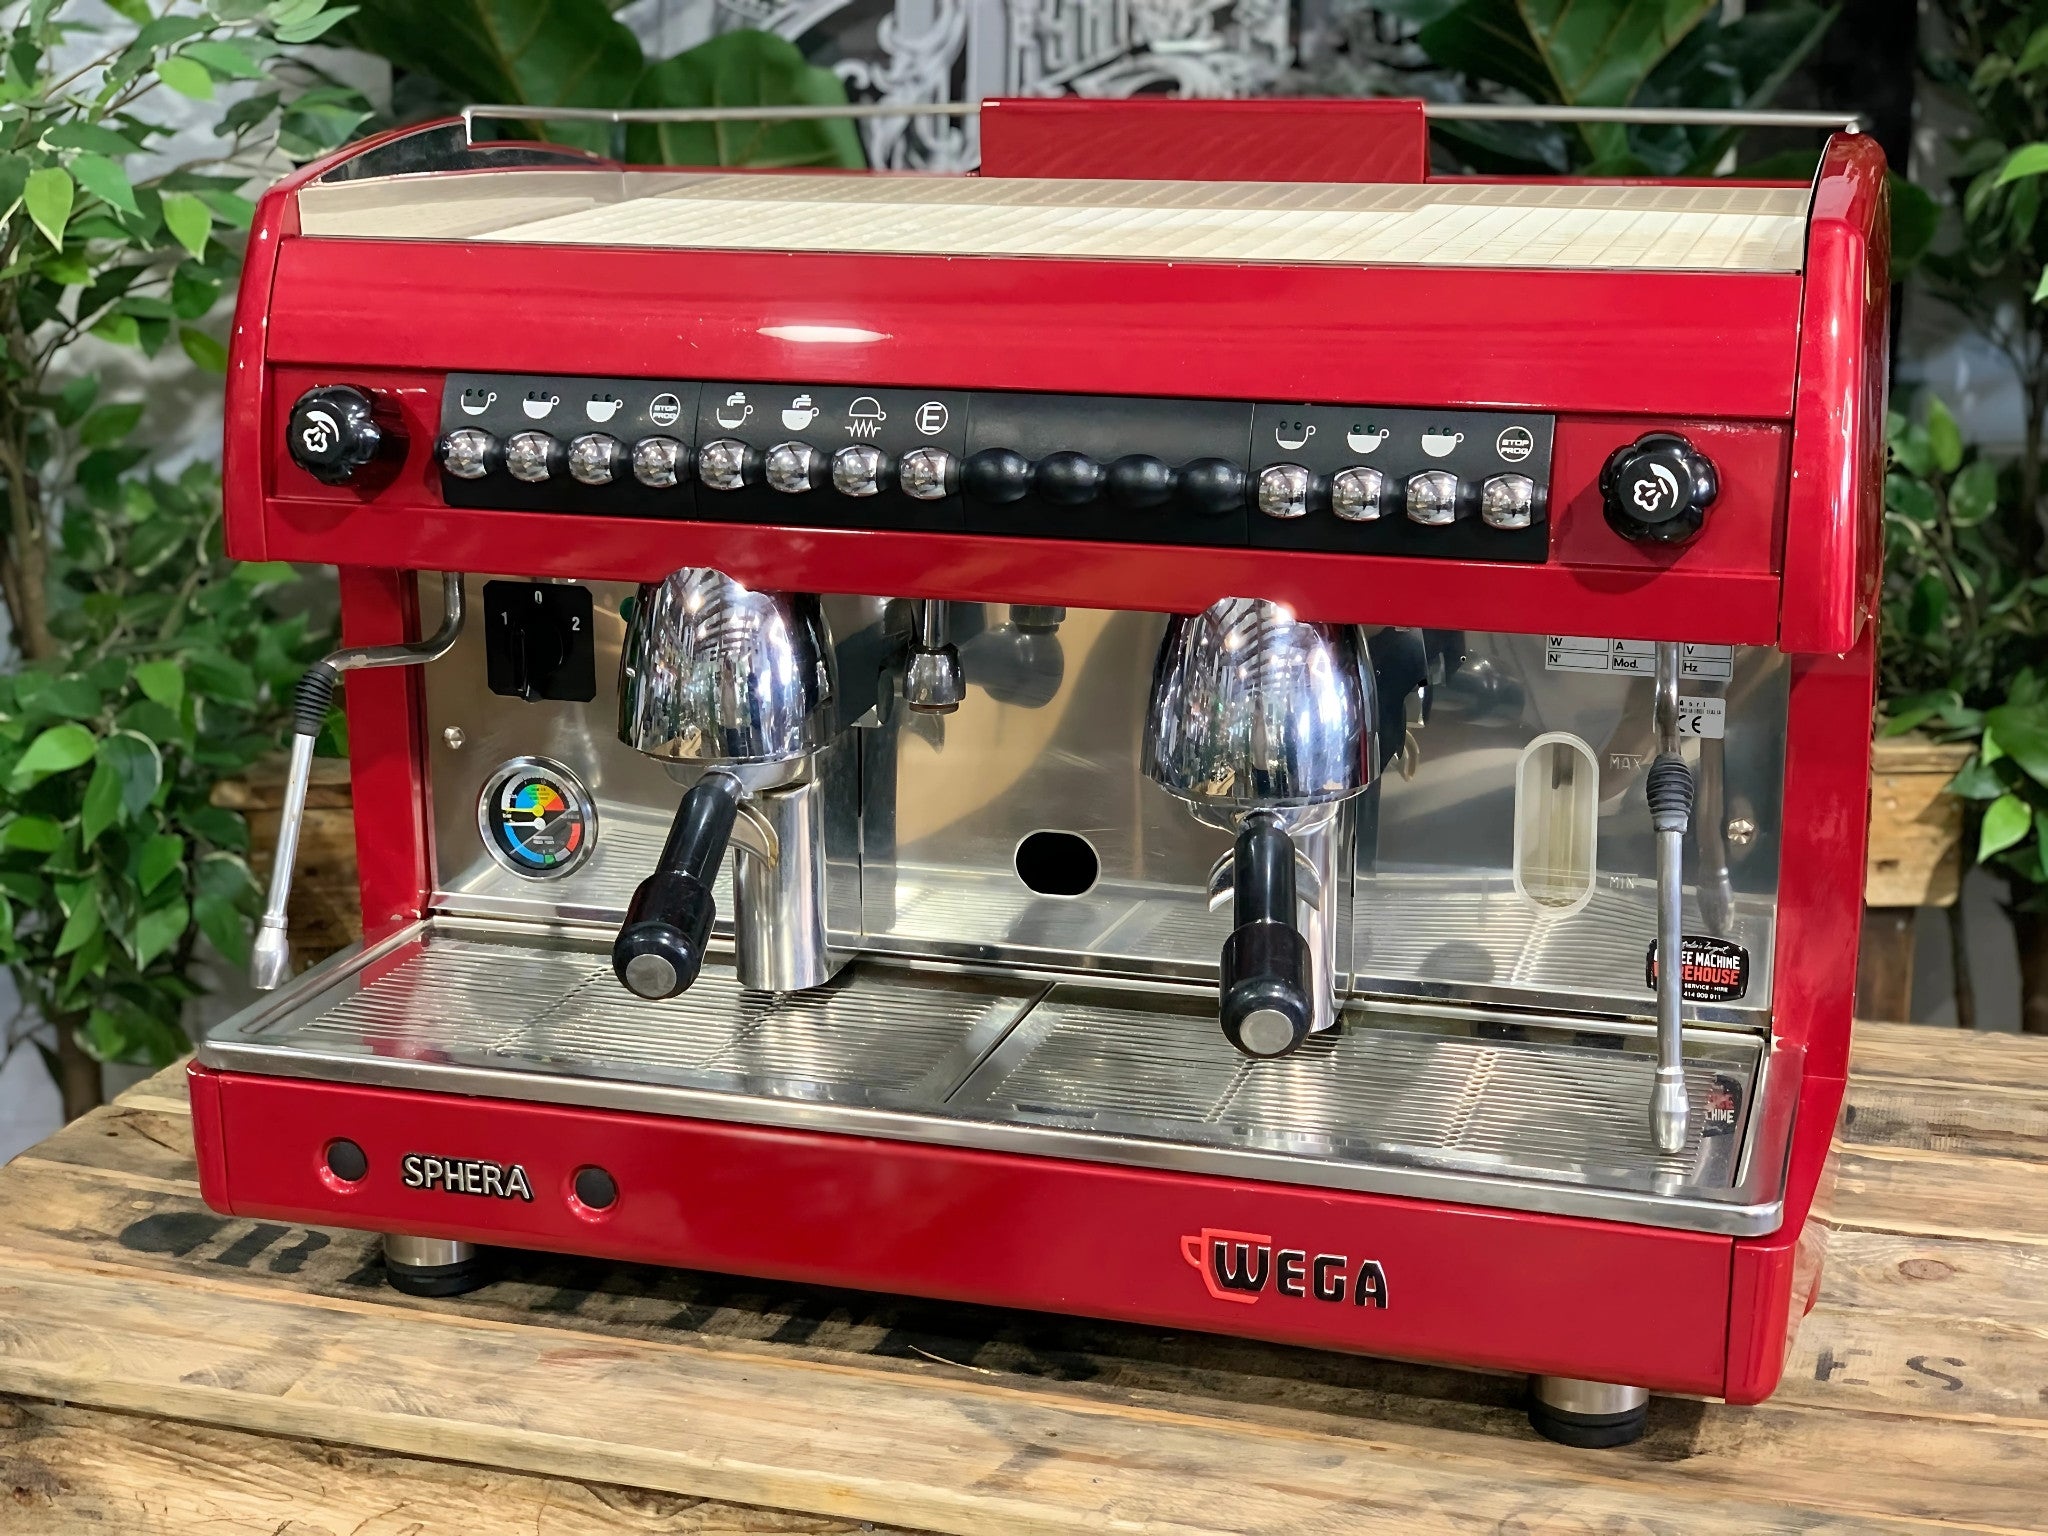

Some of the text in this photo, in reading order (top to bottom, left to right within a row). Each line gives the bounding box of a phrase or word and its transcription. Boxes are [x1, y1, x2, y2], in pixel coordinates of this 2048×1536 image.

[1500, 447, 1529, 455] PROG
[535, 591, 542, 604] 0
[501, 612, 507, 625] 1
[572, 616, 580, 631] 2
[1550, 637, 1562, 646] W
[1616, 642, 1623, 650] A
[1686, 646, 1694, 655] V
[1614, 658, 1638, 669] Mod.
[1684, 663, 1697, 672] Hz
[1610, 756, 1641, 769] MAX
[1695, 952, 1740, 970] MACHINE
[1684, 983, 1709, 991] SERVICE
[404, 1155, 531, 1200] SPHERA
[1214, 1241, 1389, 1309] WEGA
